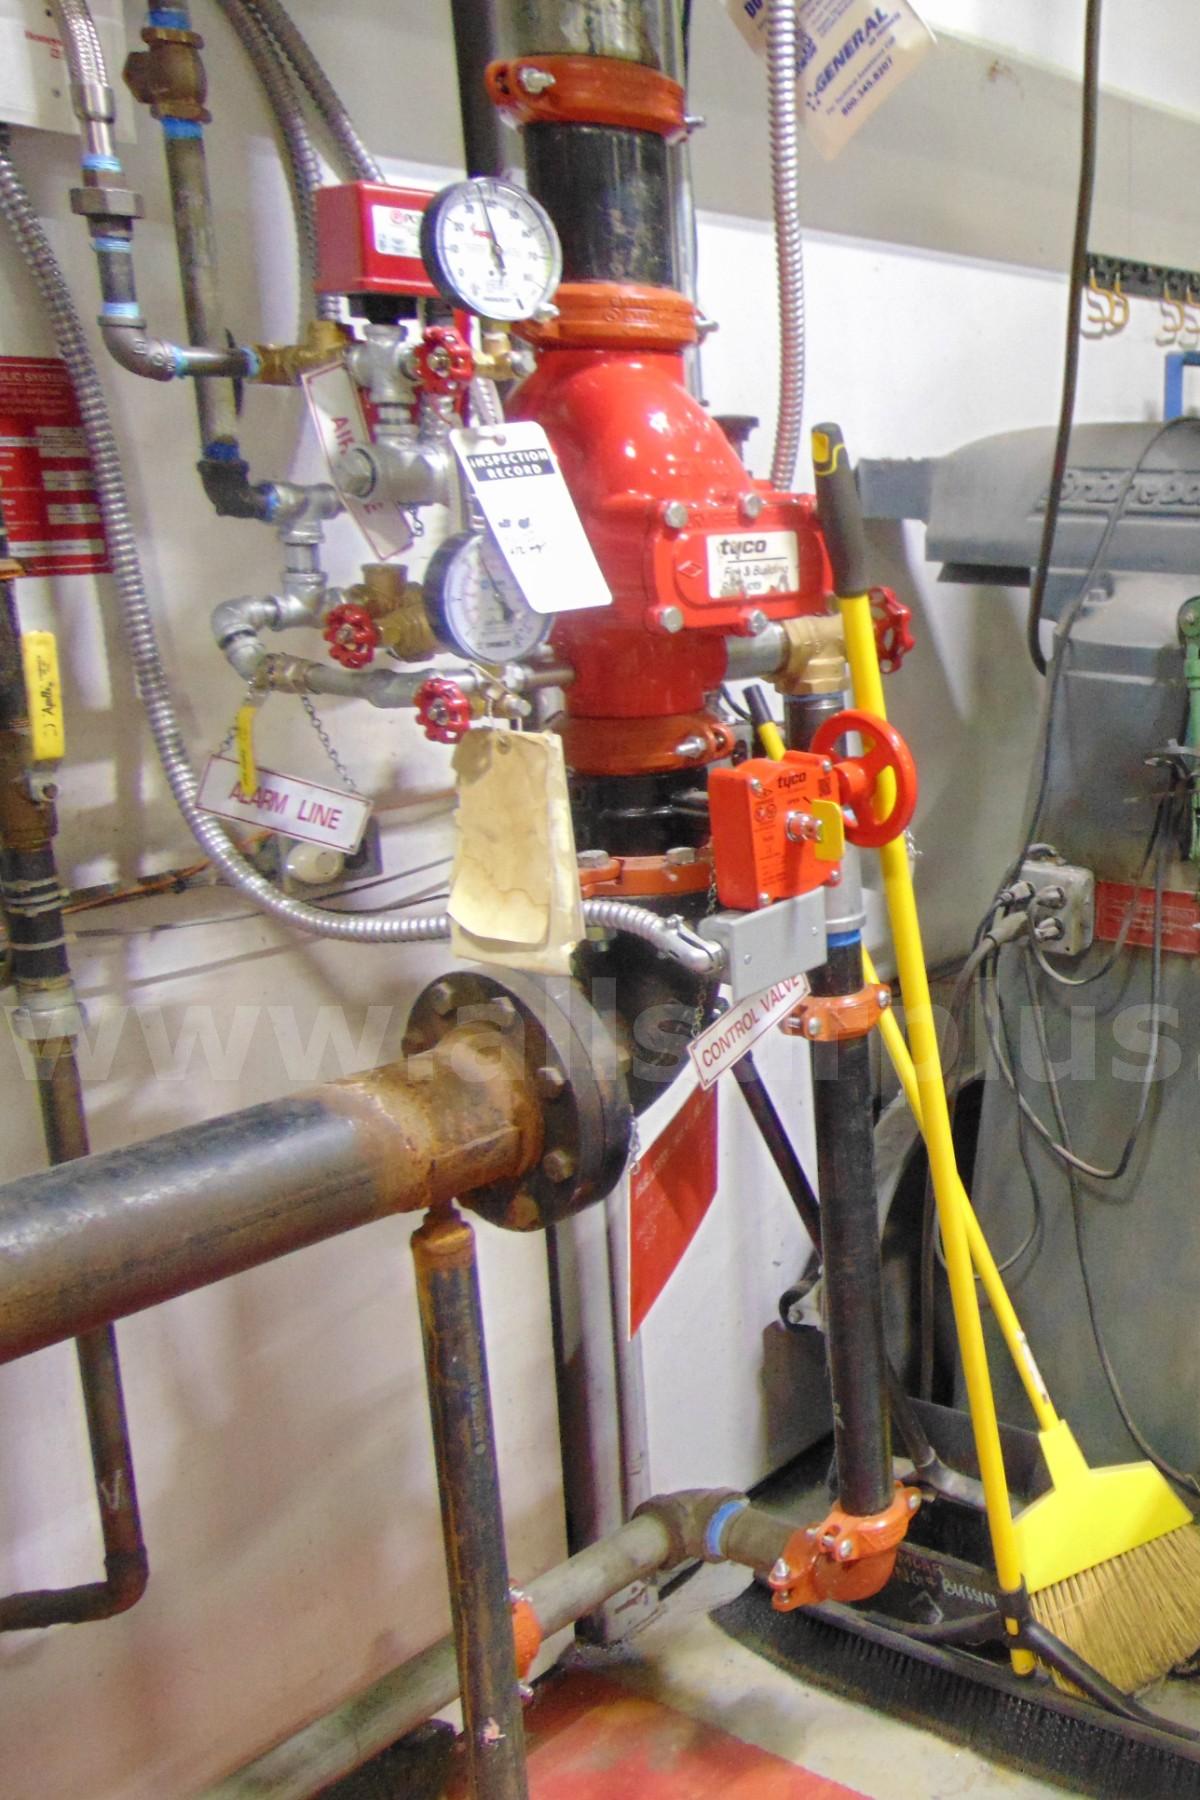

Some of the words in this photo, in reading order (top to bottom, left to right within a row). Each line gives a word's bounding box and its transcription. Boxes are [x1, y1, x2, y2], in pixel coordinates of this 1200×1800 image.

[815, 7, 888, 93] GENERAL
[469, 449, 549, 468] INSPECTION
[486, 463, 543, 480] RECORD
[720, 539, 767, 560] tyco
[777, 772, 807, 789] tyco
[296, 799, 343, 830] LINE
[702, 1008, 761, 1068] CONTROL
[760, 975, 800, 1013] VALVE
